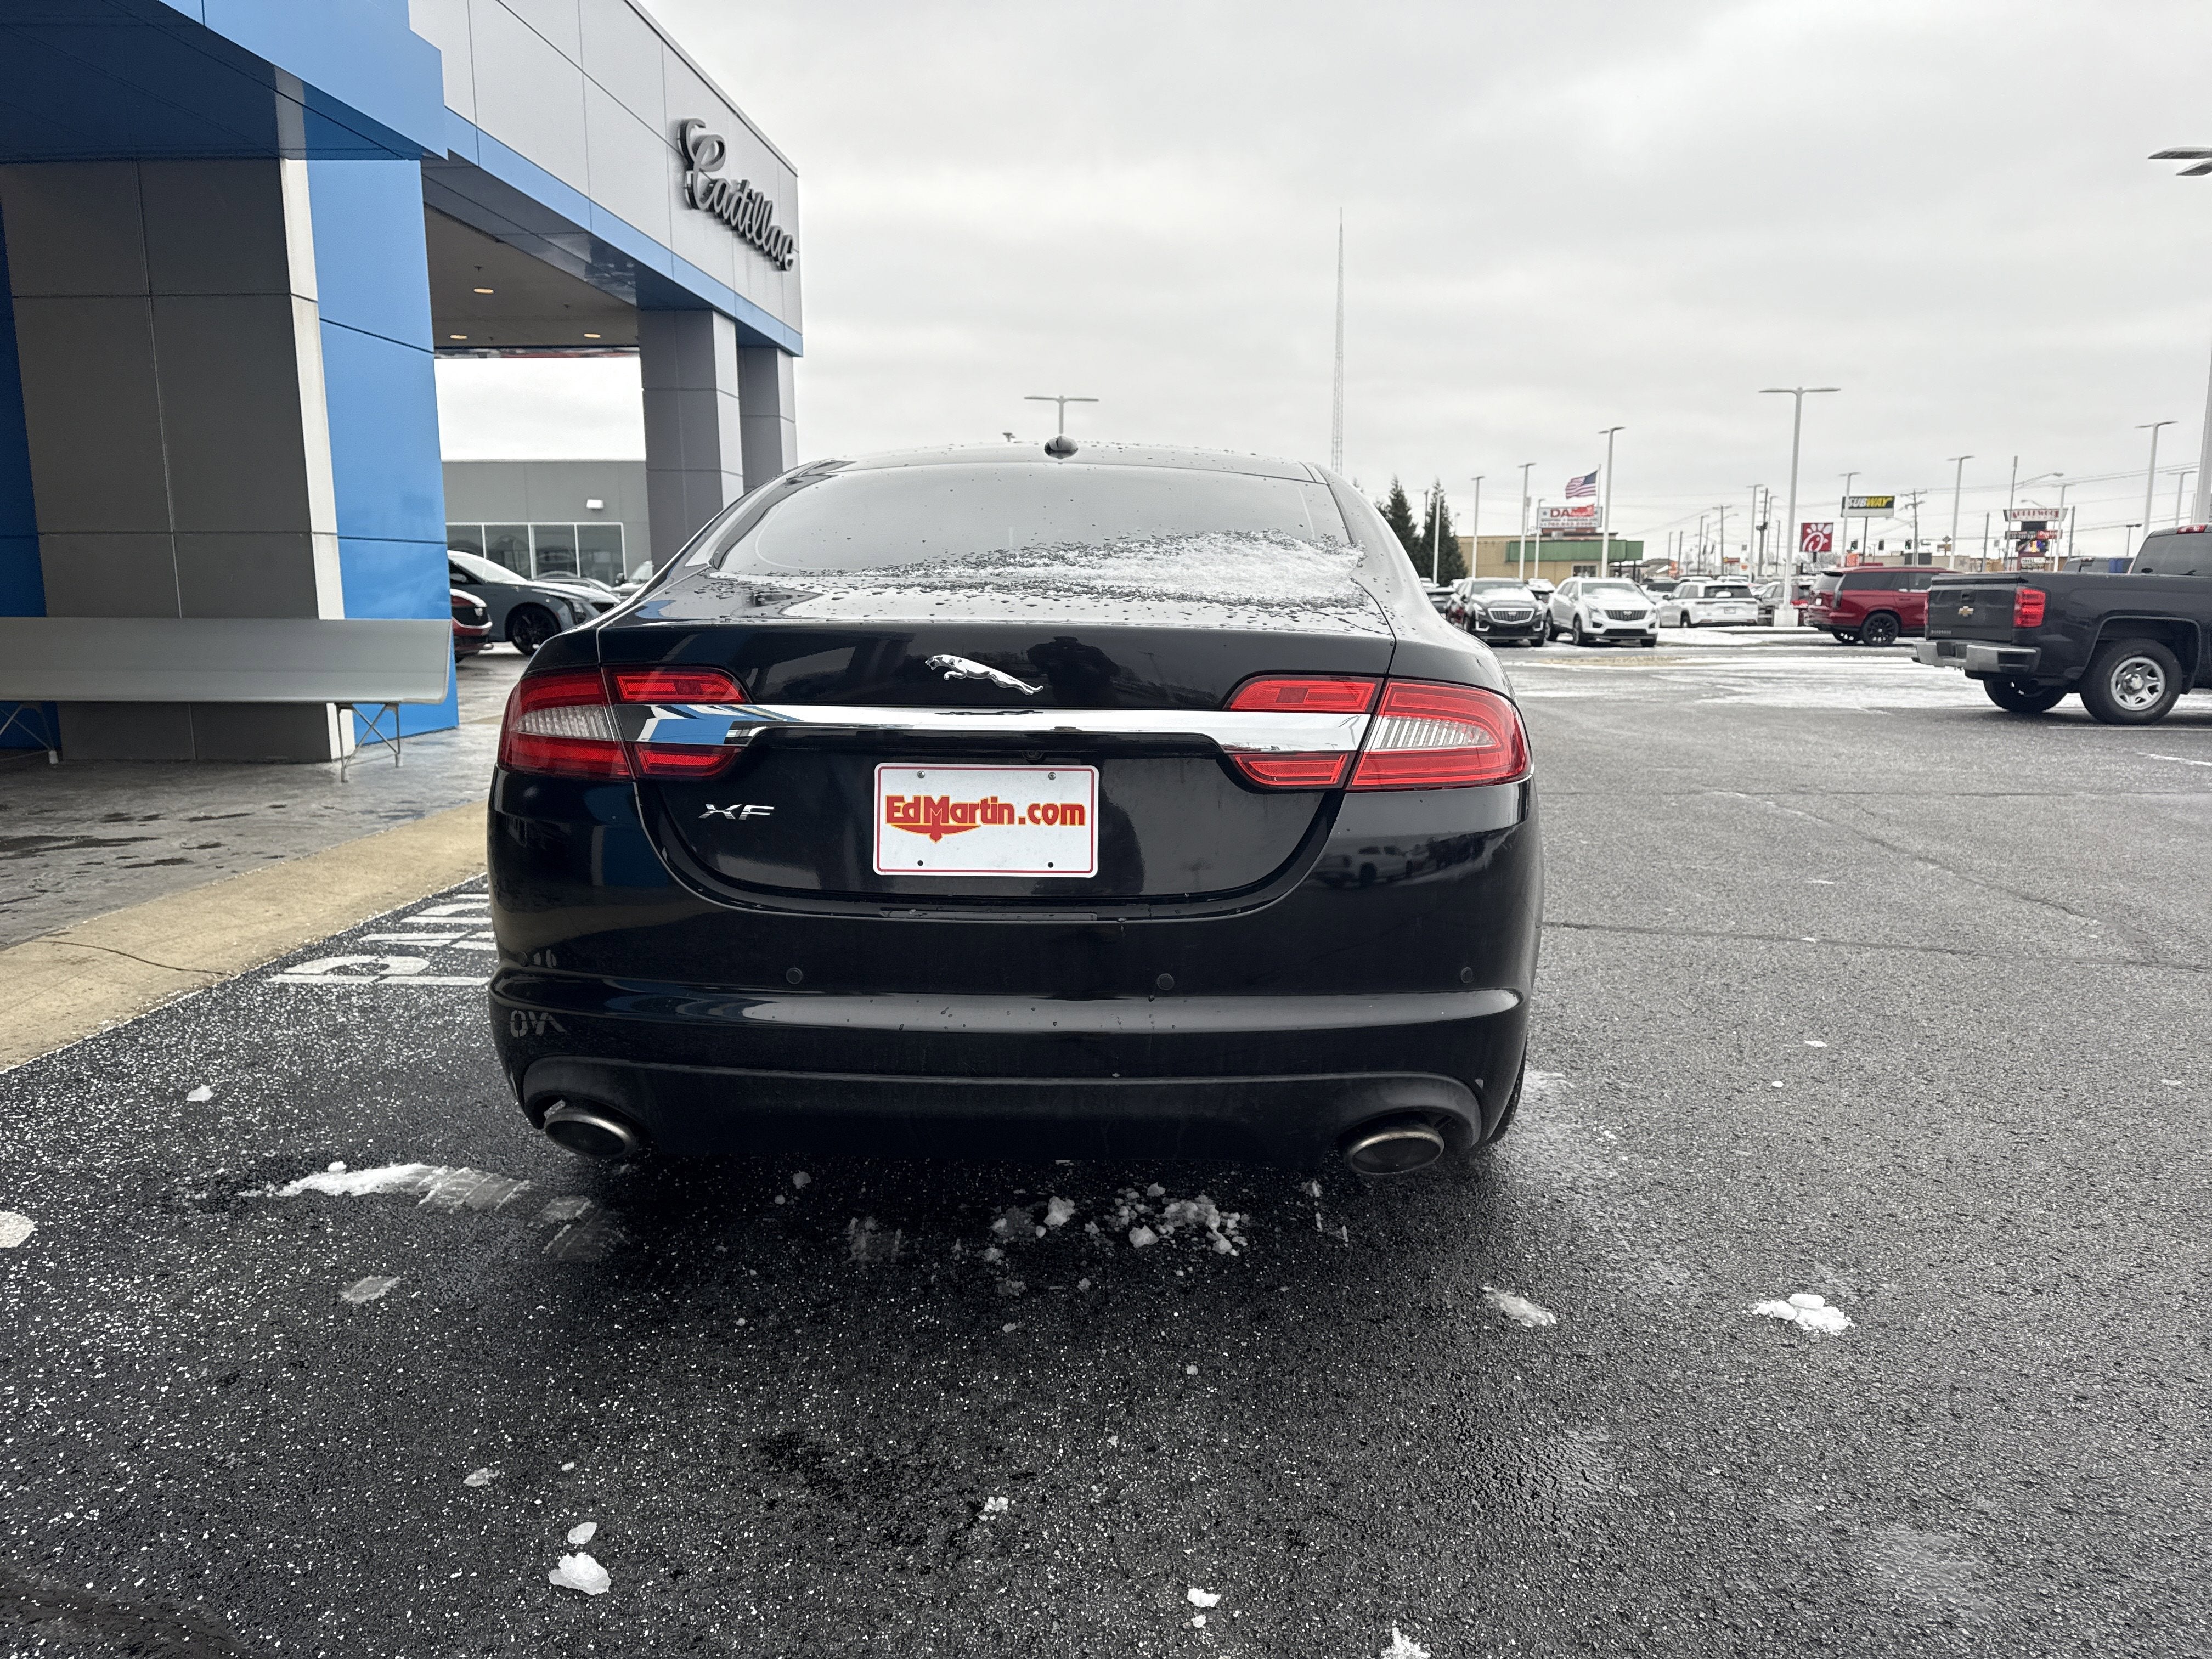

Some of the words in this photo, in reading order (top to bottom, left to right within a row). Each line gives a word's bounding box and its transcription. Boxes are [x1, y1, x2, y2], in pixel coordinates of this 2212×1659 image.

[677, 118, 794, 272] Cadillac
[1848, 496, 1893, 508] SUBWAY
[698, 803, 775, 820] XF
[885, 795, 1086, 827] EdMartin.com
